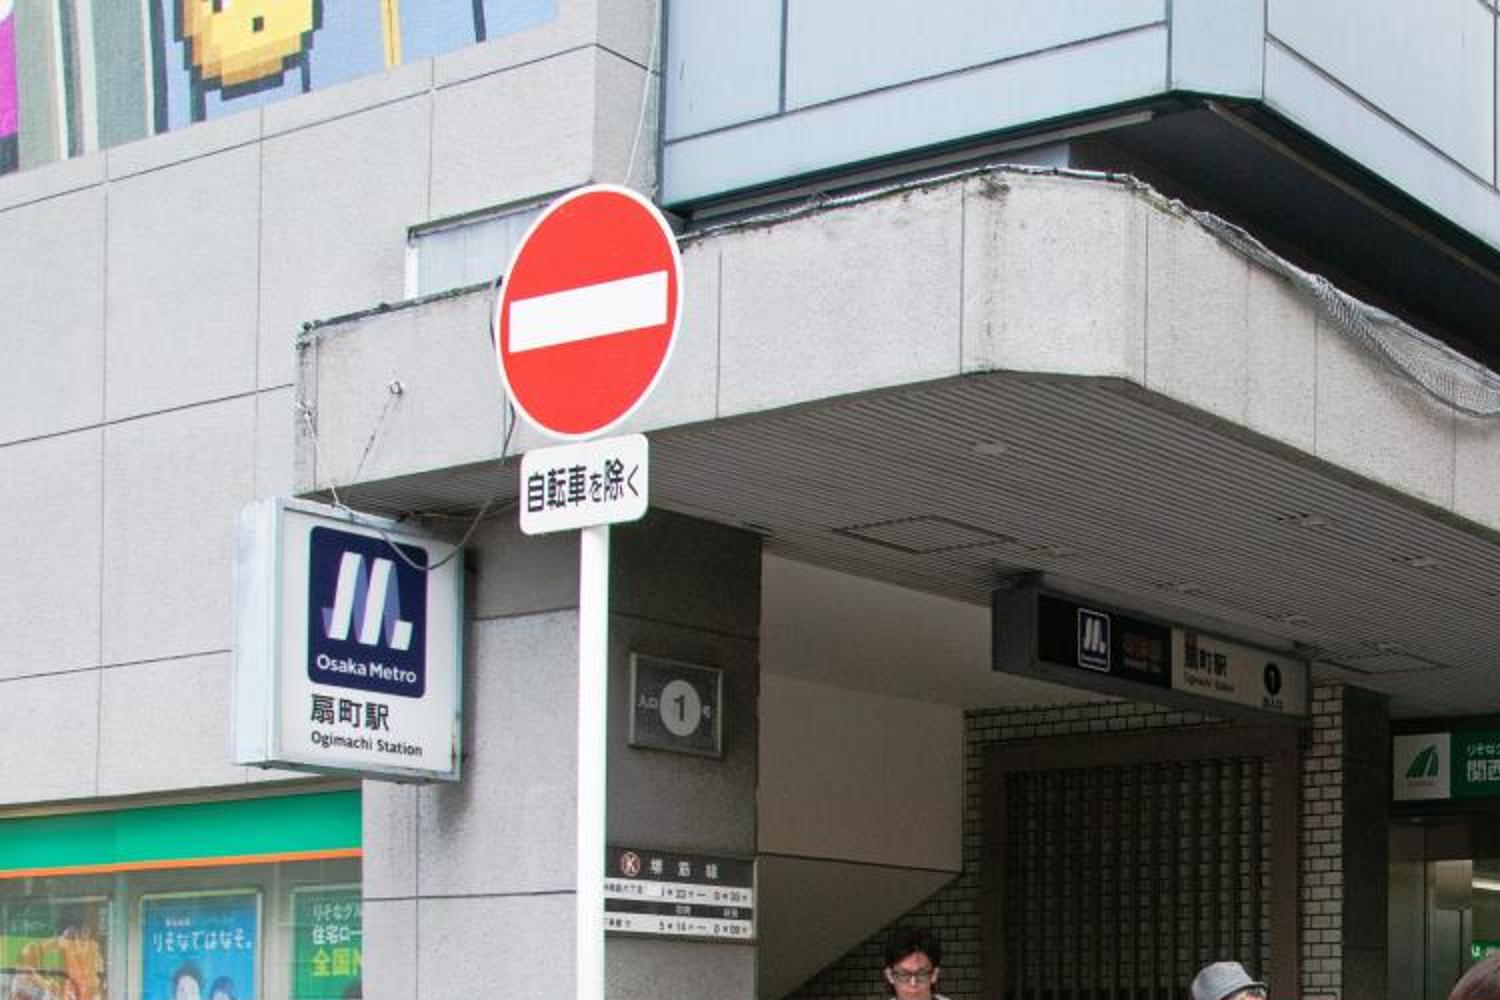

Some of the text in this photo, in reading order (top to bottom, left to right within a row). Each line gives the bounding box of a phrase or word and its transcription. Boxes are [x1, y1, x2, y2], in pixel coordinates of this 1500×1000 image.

[528, 458, 639, 513] 自転車を除く
[316, 654, 418, 684] Osaka Metro
[310, 693, 390, 732] 扇町駅
[673, 694, 686, 722] 1
[311, 731, 423, 757] Ogimachi Station
